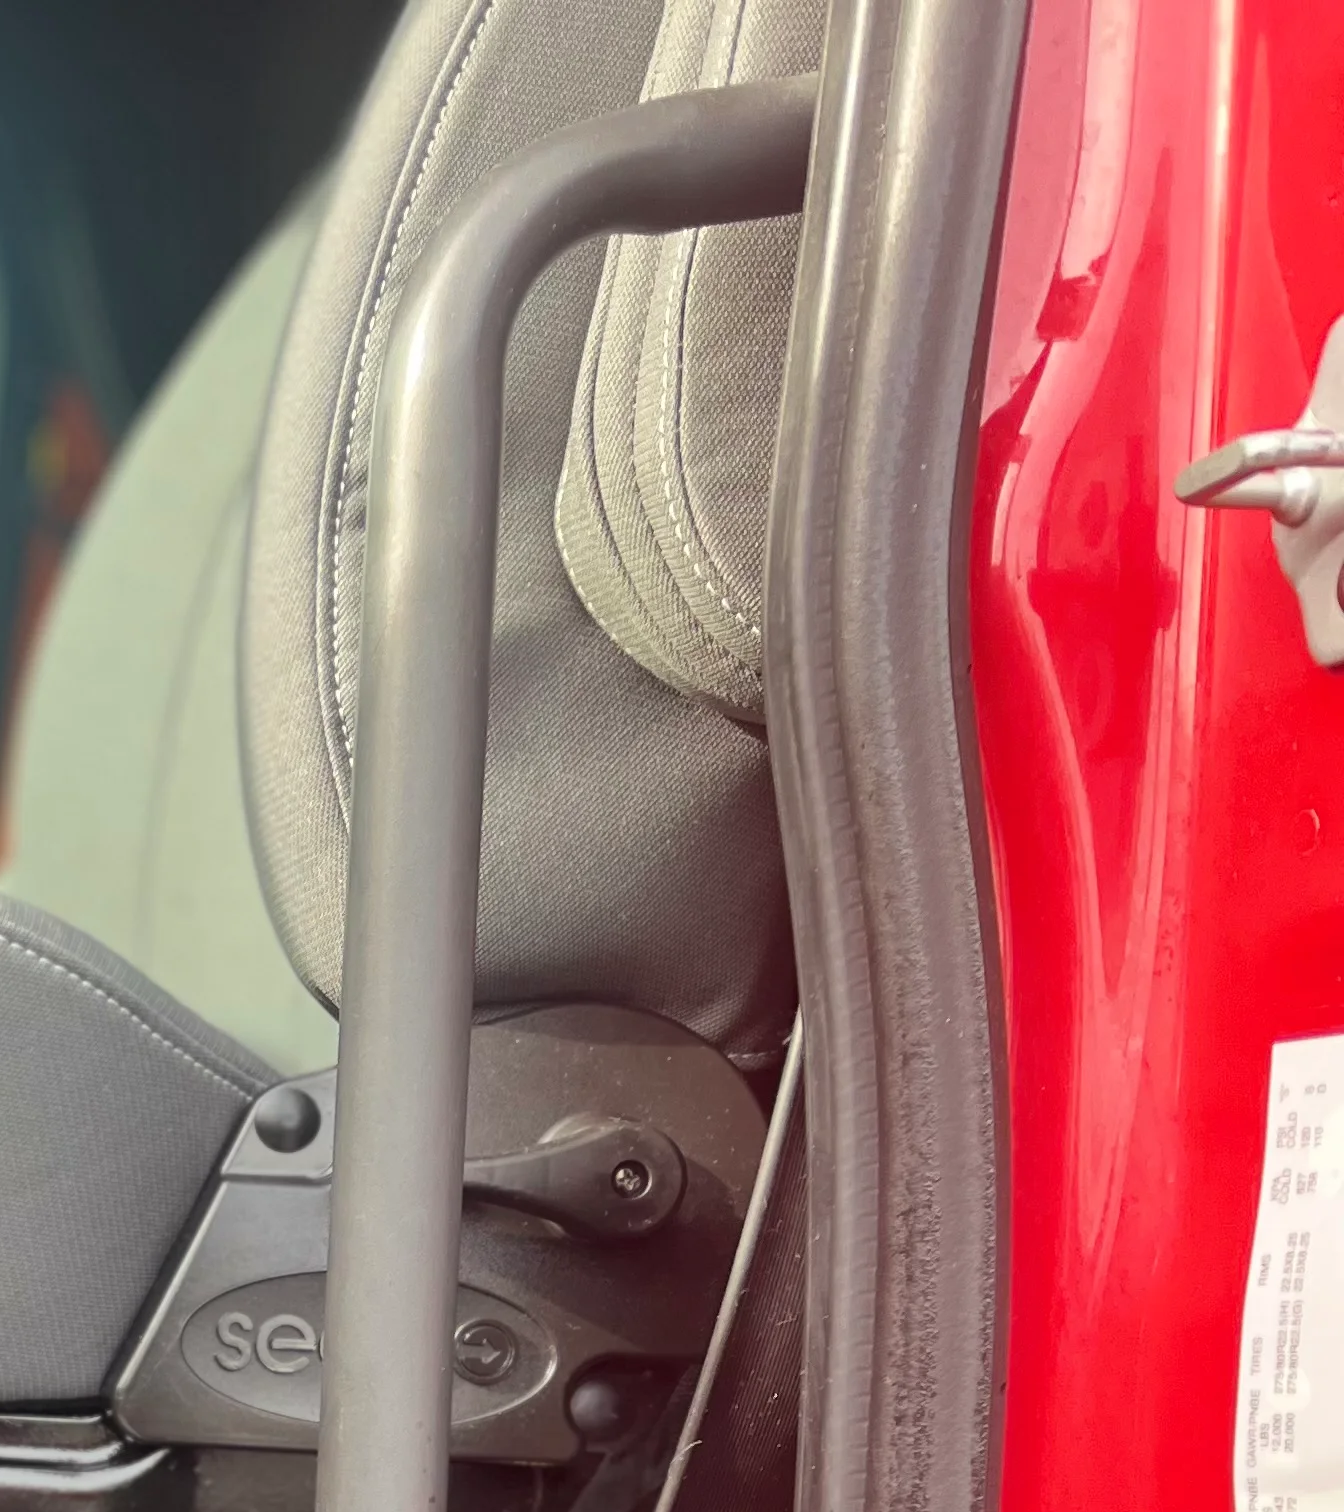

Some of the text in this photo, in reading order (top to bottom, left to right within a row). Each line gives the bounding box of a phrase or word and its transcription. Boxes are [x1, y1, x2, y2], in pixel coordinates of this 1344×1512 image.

[1276, 1126, 1287, 1149] PSI
[1286, 1111, 1298, 1149] COLD
[1270, 1175, 1282, 1202] KPA
[1279, 1167, 1292, 1205] COLD
[1257, 1253, 1272, 1287] RIMS
[1250, 1336, 1264, 1377] TIRES
[1246, 1389, 1261, 1468] GAWR/PNBE
[1259, 1423, 1270, 1448] LBS
